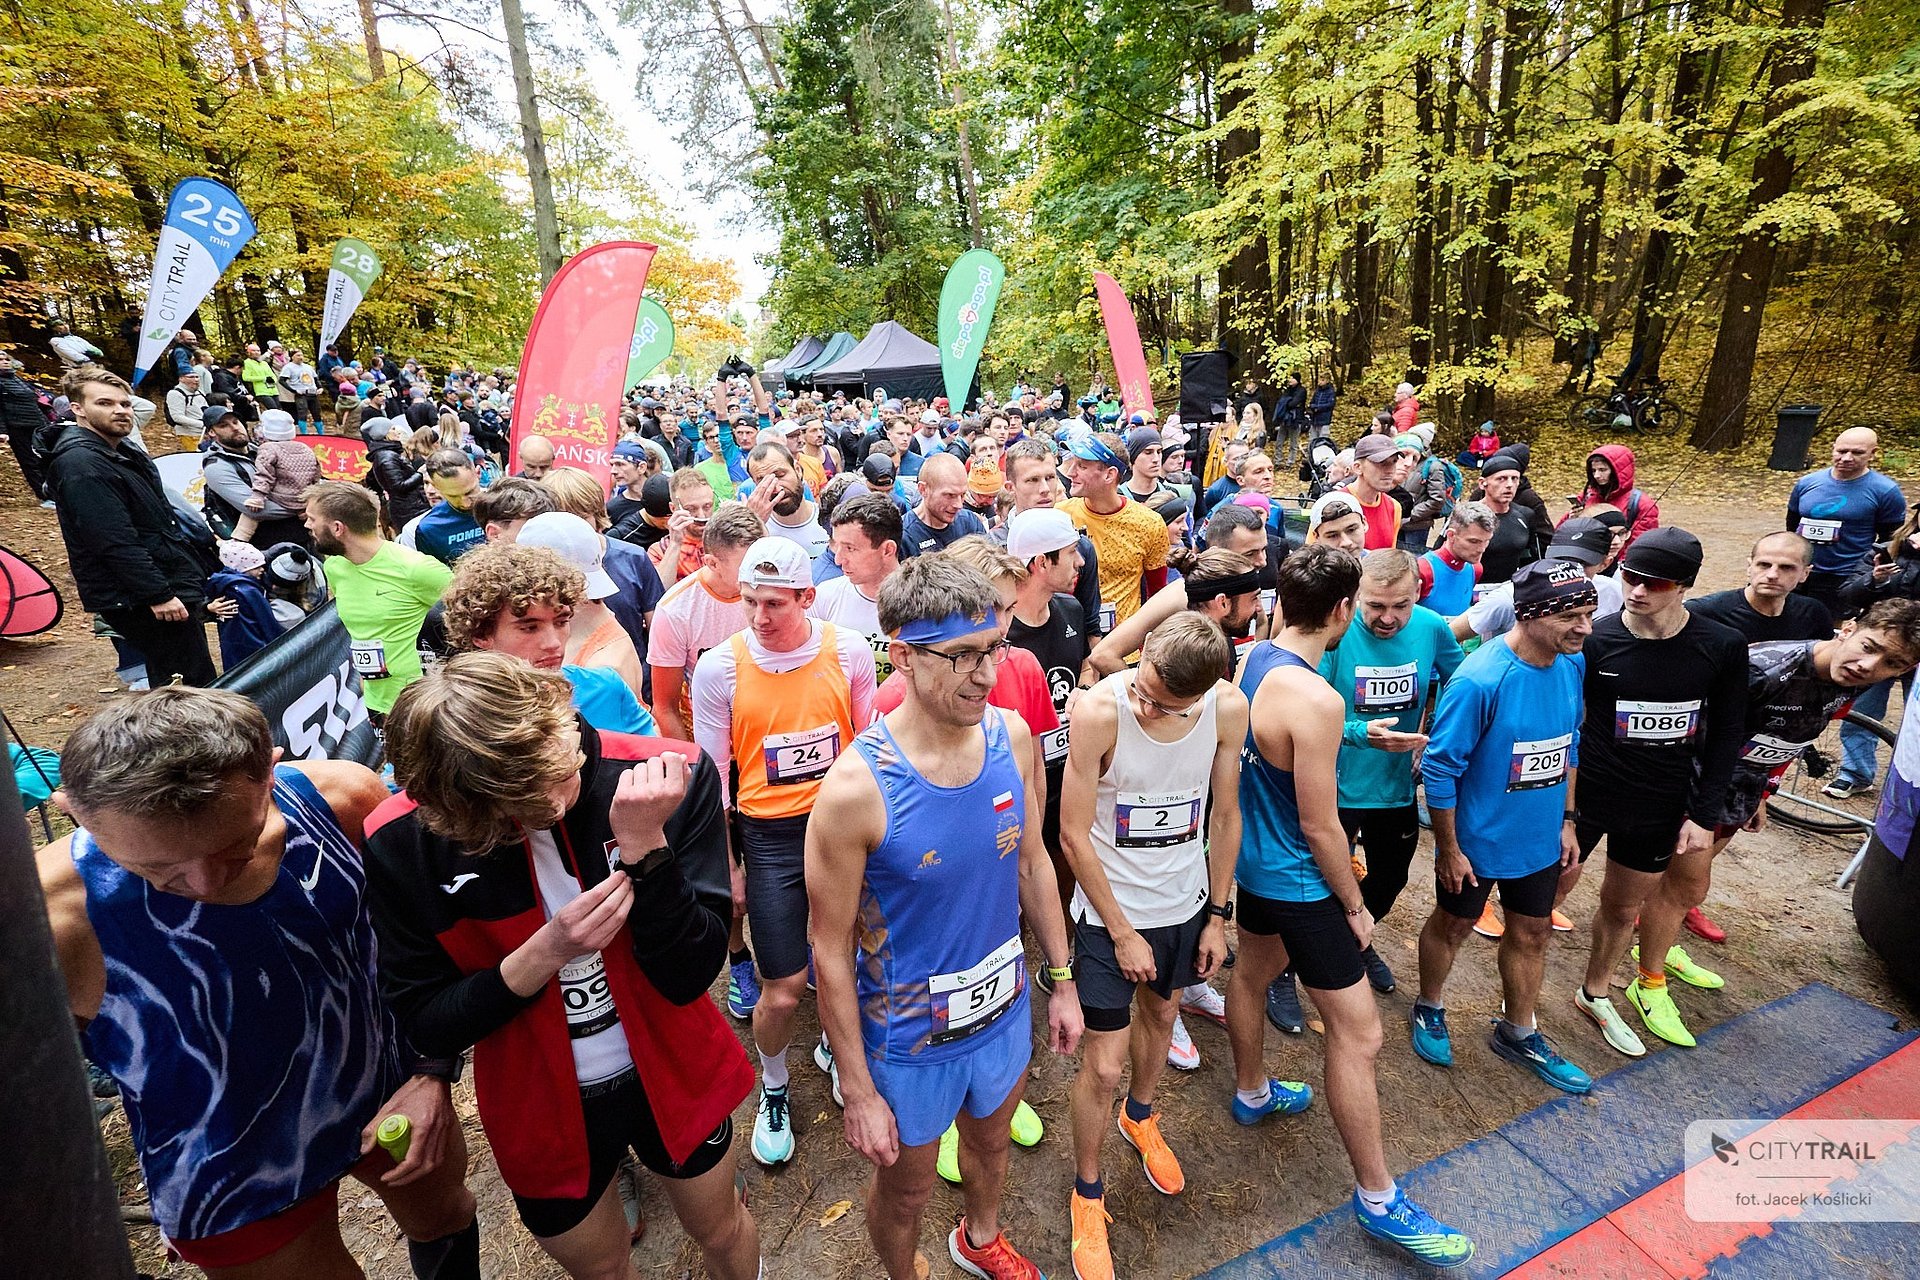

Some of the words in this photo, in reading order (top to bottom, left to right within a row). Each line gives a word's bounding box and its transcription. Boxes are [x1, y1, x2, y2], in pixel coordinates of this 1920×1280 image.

[181, 193, 242, 236] 25
[210, 235, 231, 249] min
[340, 247, 375, 273] 28
[553, 443, 609, 467] AŃSK
[448, 527, 485, 545] POME
[1809, 527, 1824, 536] 95
[1371, 680, 1410, 695] 1100
[1631, 715, 1687, 731] 1086
[792, 746, 822, 766] 24
[1528, 753, 1561, 772] 209
[1154, 810, 1169, 827] 2
[969, 975, 1000, 1010] 57
